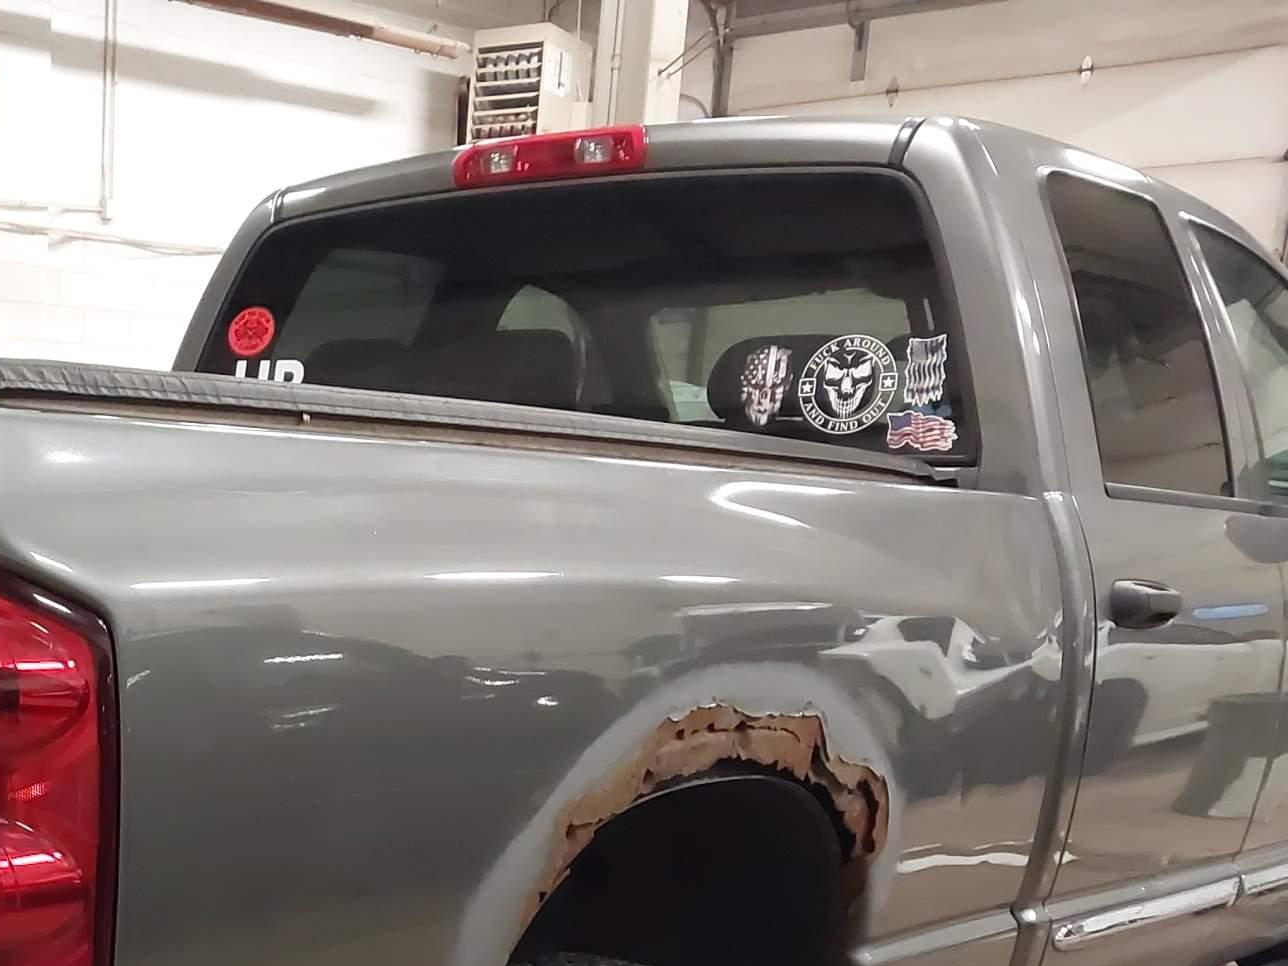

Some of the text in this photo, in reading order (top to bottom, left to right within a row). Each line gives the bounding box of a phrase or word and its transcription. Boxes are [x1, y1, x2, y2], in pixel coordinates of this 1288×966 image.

[809, 337, 891, 370] FUCK AROUND
[803, 398, 886, 432] AND FIND OUT
